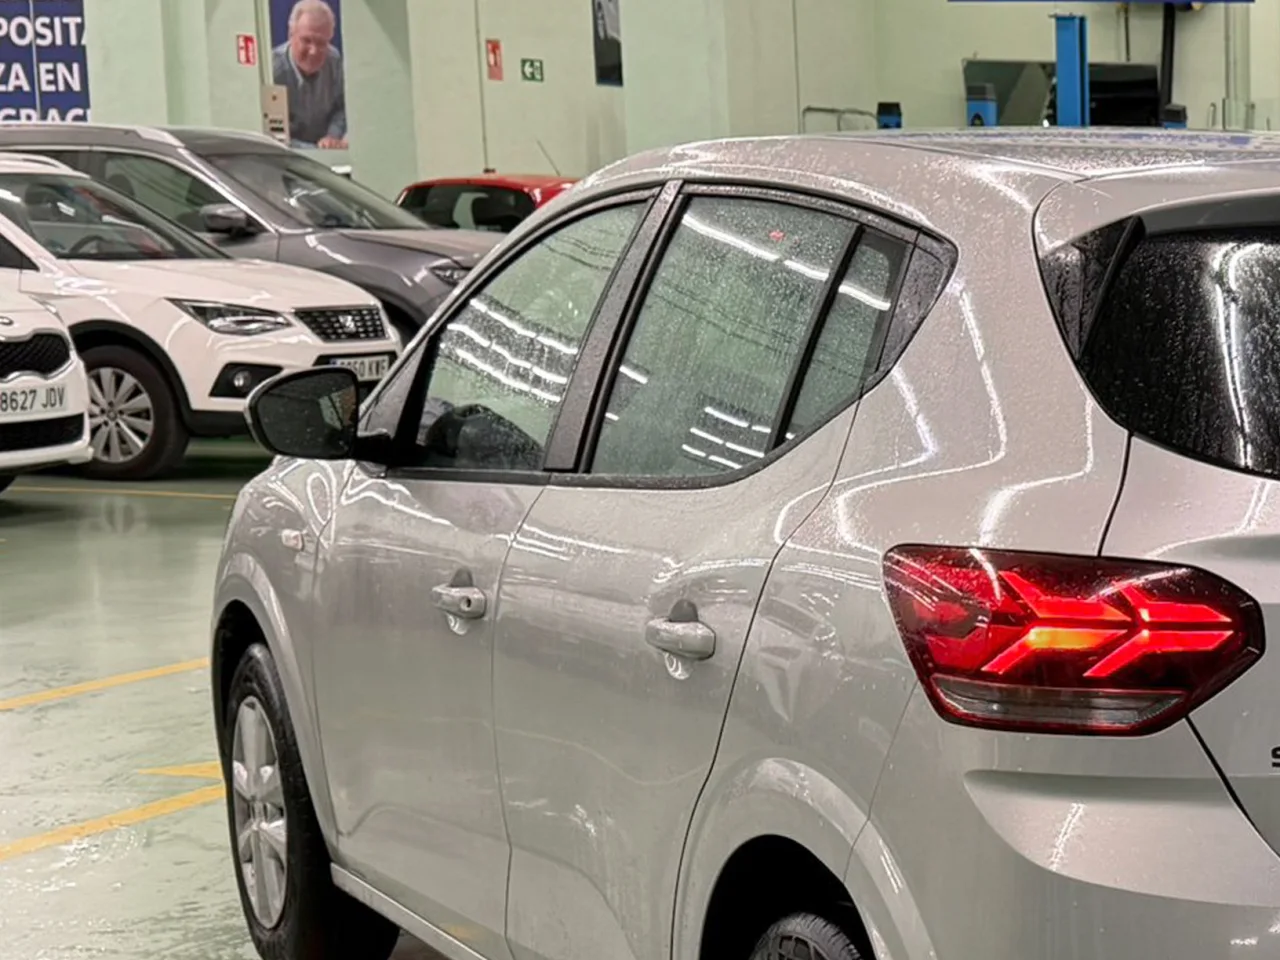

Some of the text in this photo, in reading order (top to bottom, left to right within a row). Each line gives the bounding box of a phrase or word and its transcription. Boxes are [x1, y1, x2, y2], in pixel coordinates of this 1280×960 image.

[0, 16, 86, 46] OSIT
[40, 62, 81, 92] EN
[0, 389, 37, 412] 8627
